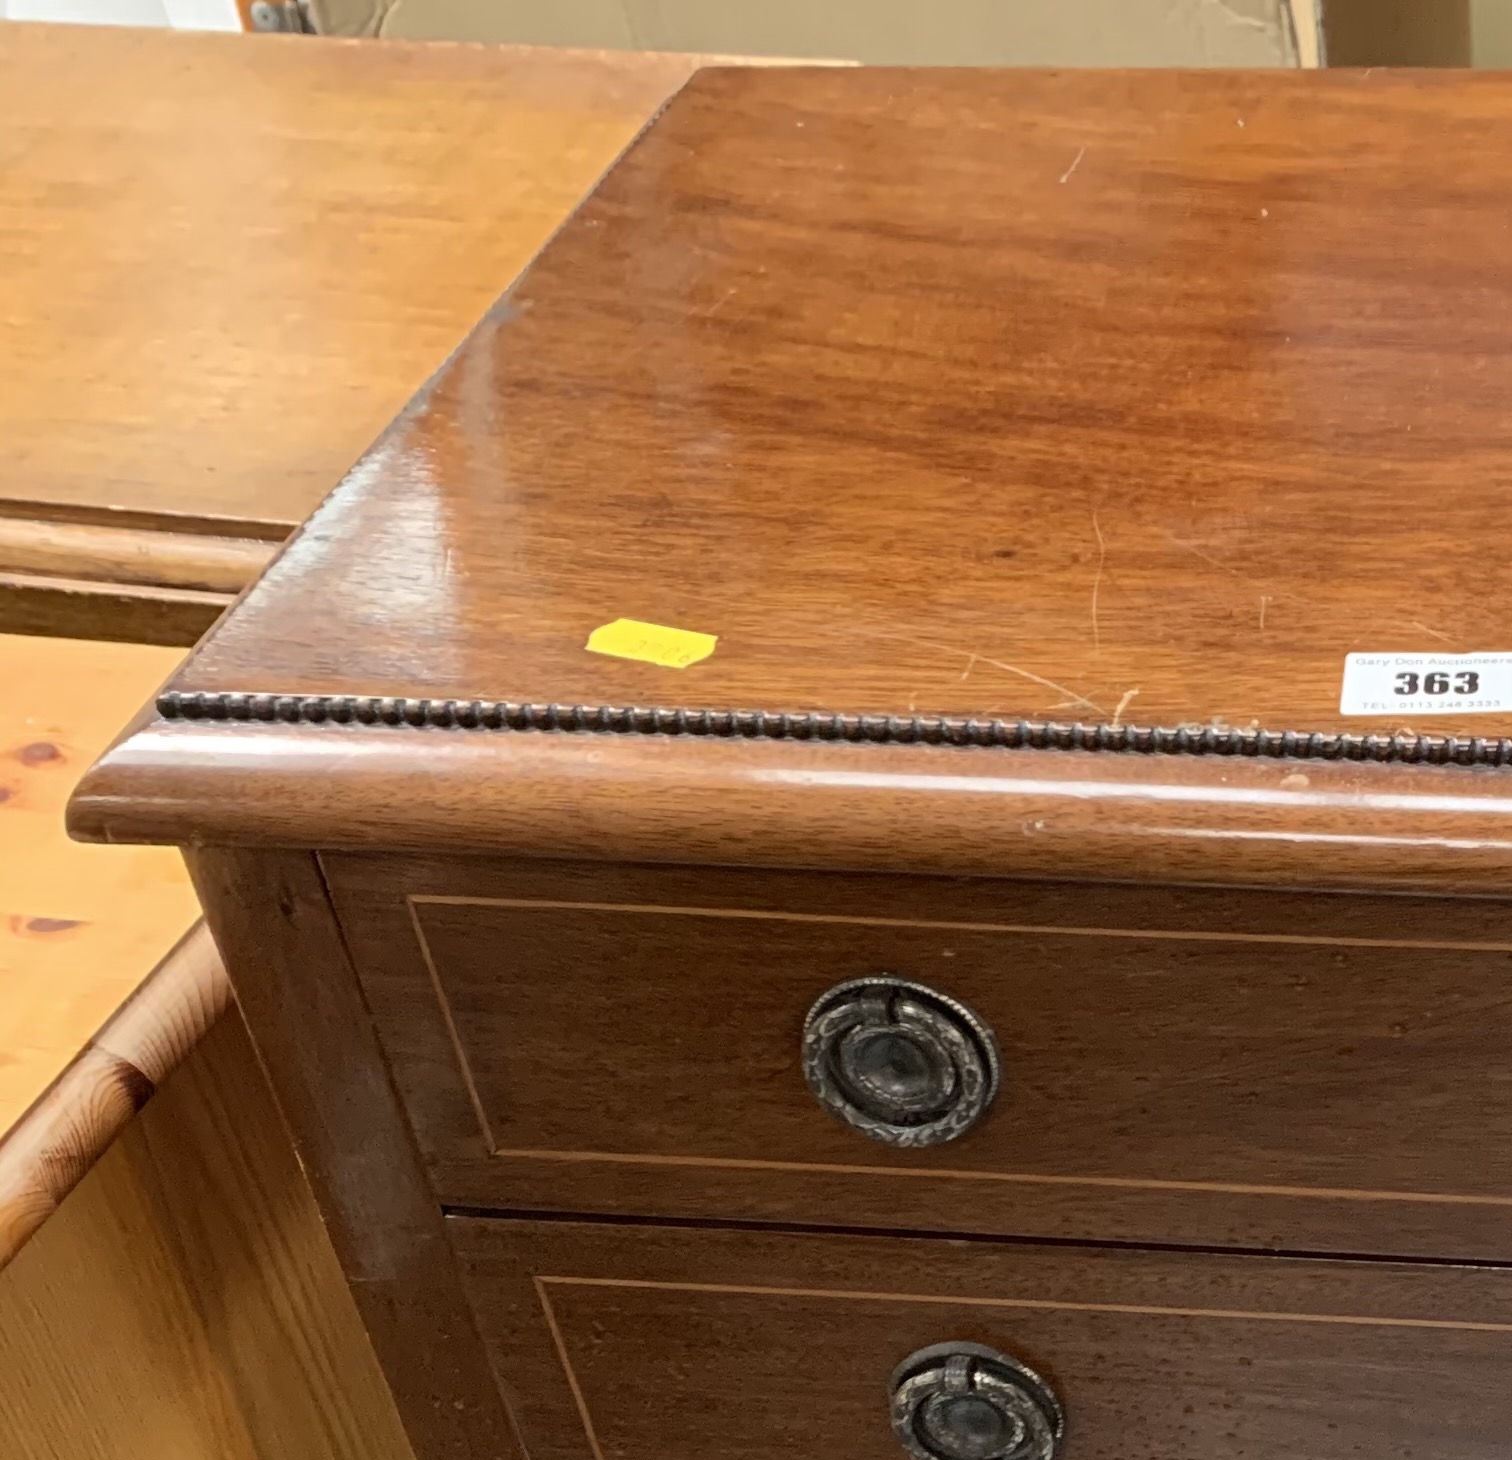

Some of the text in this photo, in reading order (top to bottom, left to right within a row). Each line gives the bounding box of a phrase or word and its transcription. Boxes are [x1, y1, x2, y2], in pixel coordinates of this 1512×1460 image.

[1355, 657, 1512, 667] Gary Don Auctioneers
[1393, 670, 1480, 696] 363
[1398, 701, 1433, 709] 0113
[1467, 699, 1501, 708] 3333
